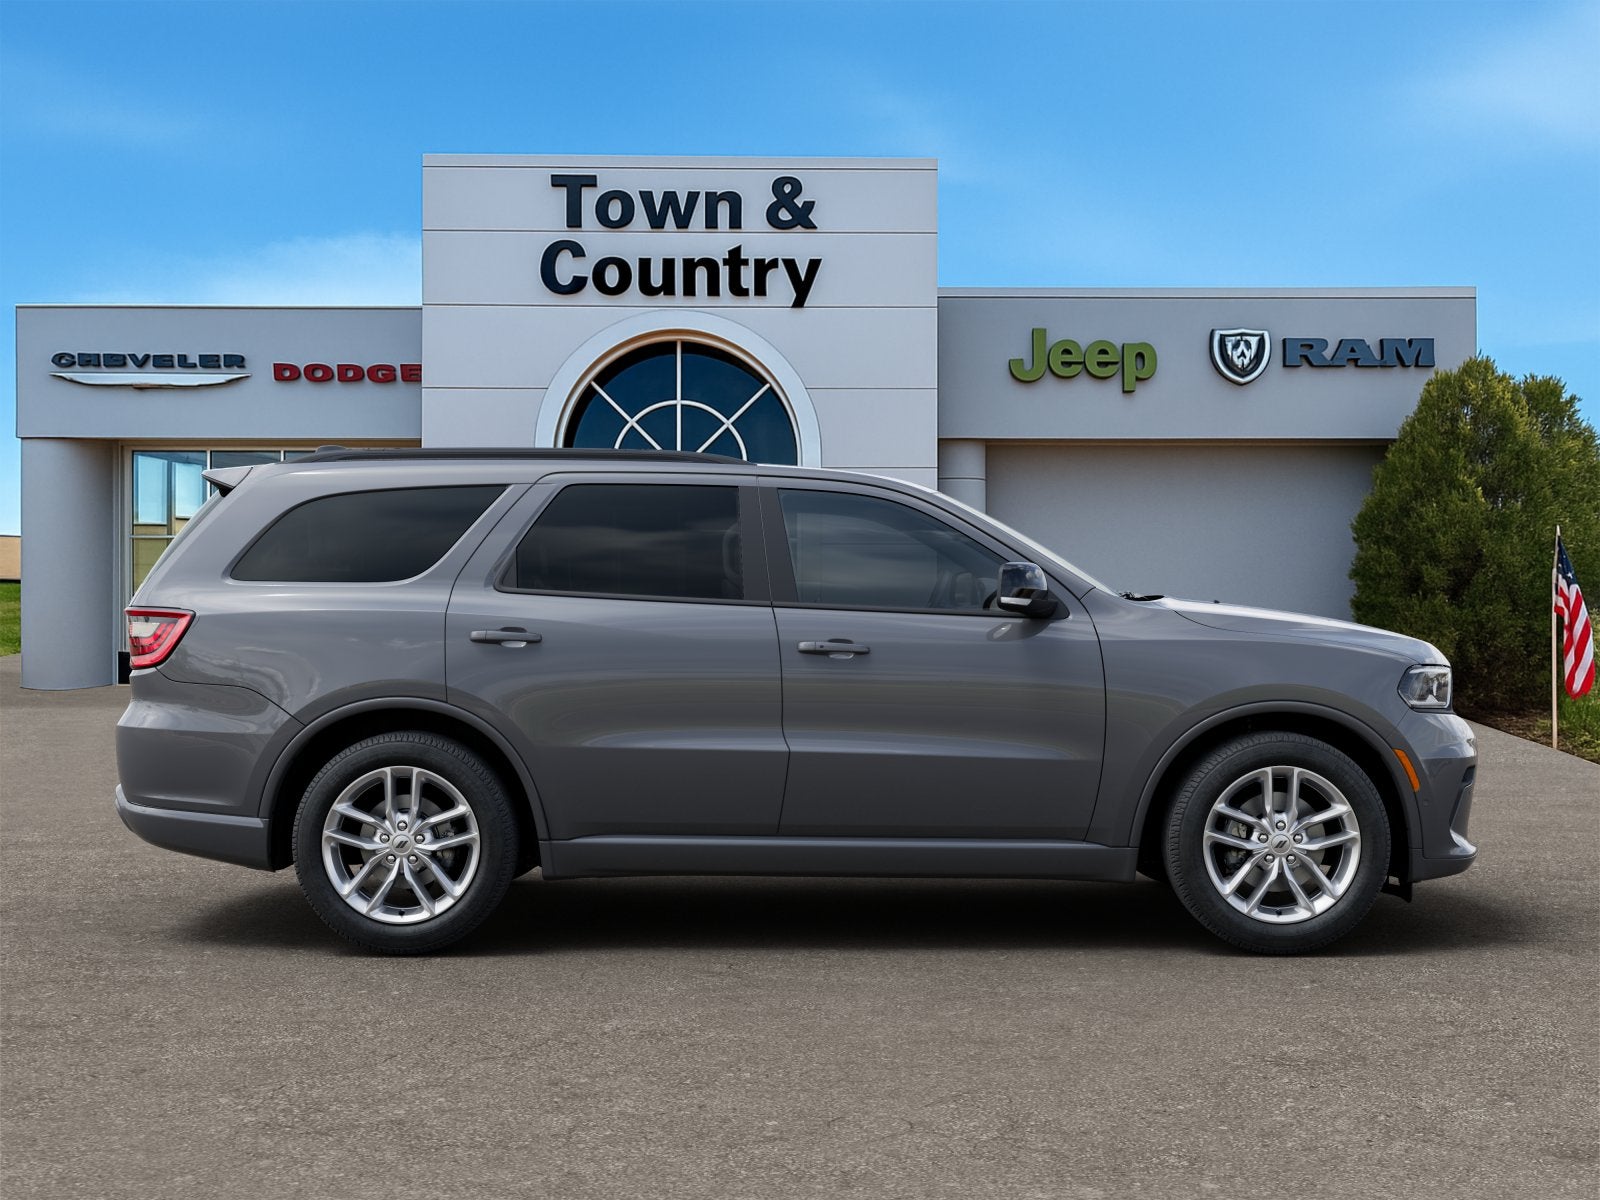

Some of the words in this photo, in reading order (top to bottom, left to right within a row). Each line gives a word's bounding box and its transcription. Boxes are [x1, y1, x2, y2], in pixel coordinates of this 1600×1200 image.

[550, 174, 742, 229] Town
[765, 176, 818, 229] &
[540, 239, 822, 308] Country
[273, 363, 422, 383] DODGE
[1009, 328, 1157, 393] Jeep
[1282, 338, 1435, 368] RAM
